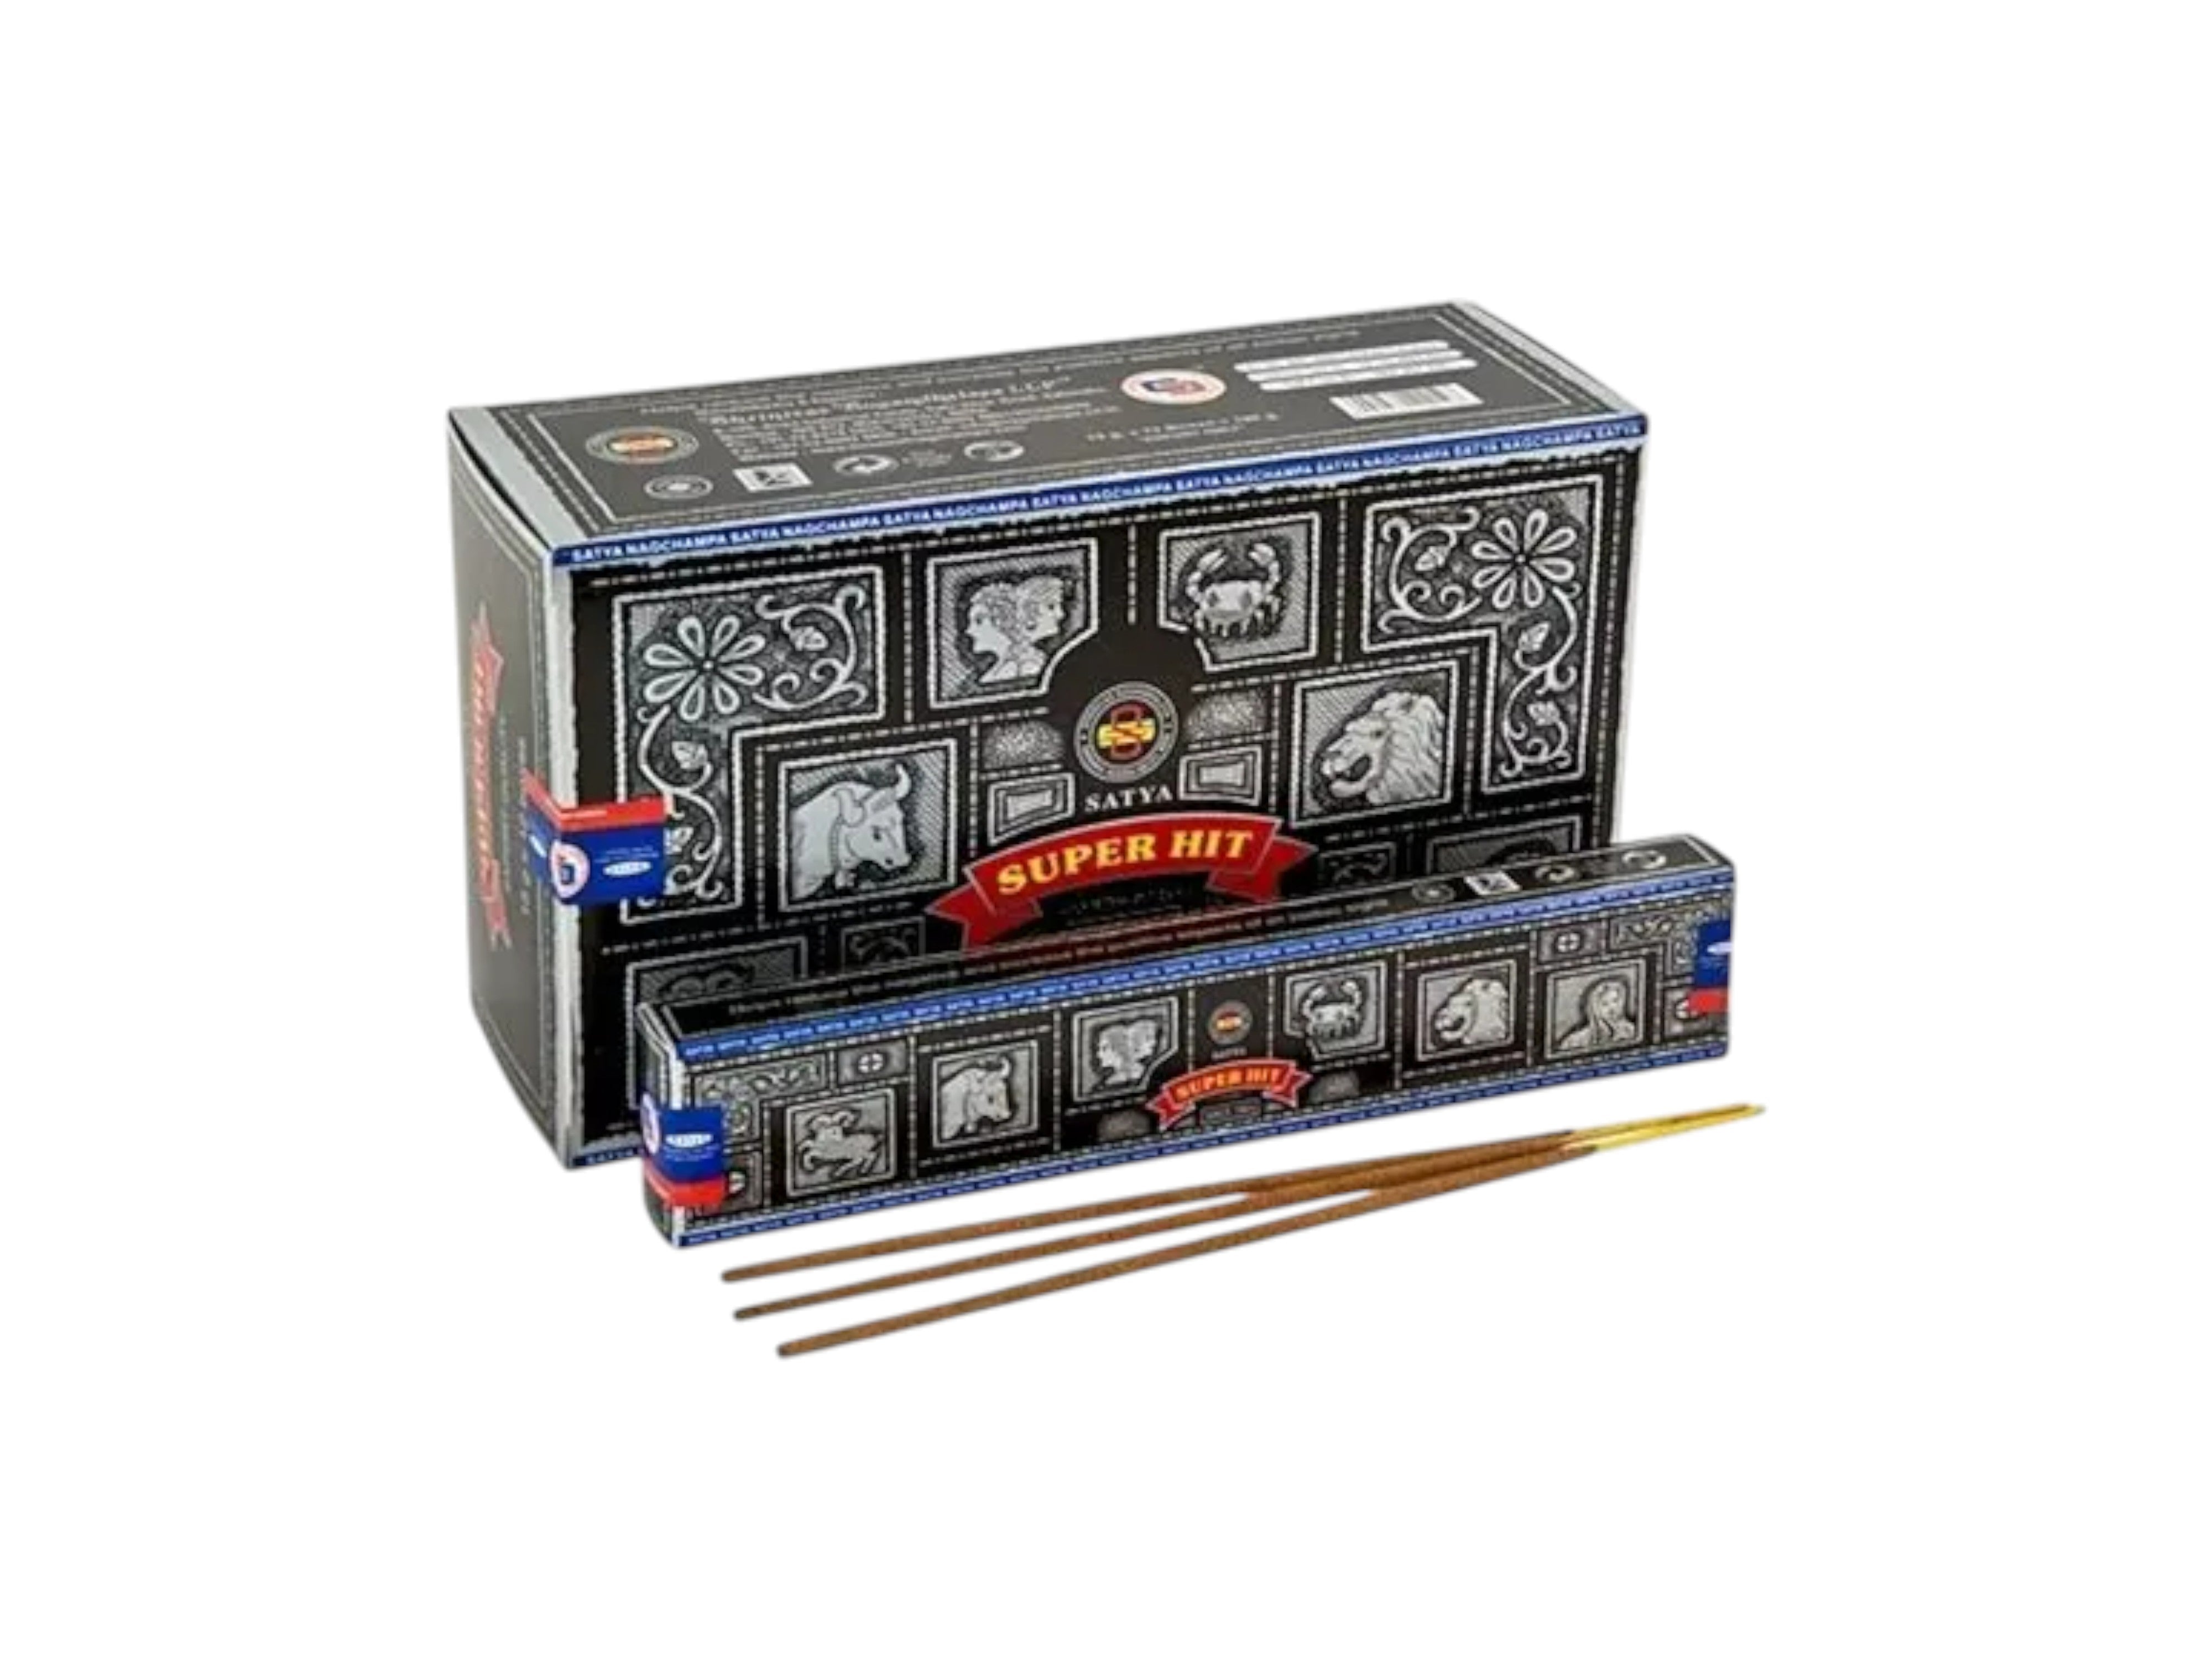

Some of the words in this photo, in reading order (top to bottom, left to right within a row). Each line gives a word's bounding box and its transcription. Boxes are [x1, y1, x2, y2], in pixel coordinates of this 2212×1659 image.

[573, 543, 623, 563] SATYA
[732, 525, 779, 543] SATYA
[1085, 785, 1173, 813] SATYA
[997, 832, 1158, 896] SUPER
[1168, 830, 1254, 859] HIT
[1176, 1070, 1242, 1103] SUPER
[1245, 1067, 1284, 1083] HIT
